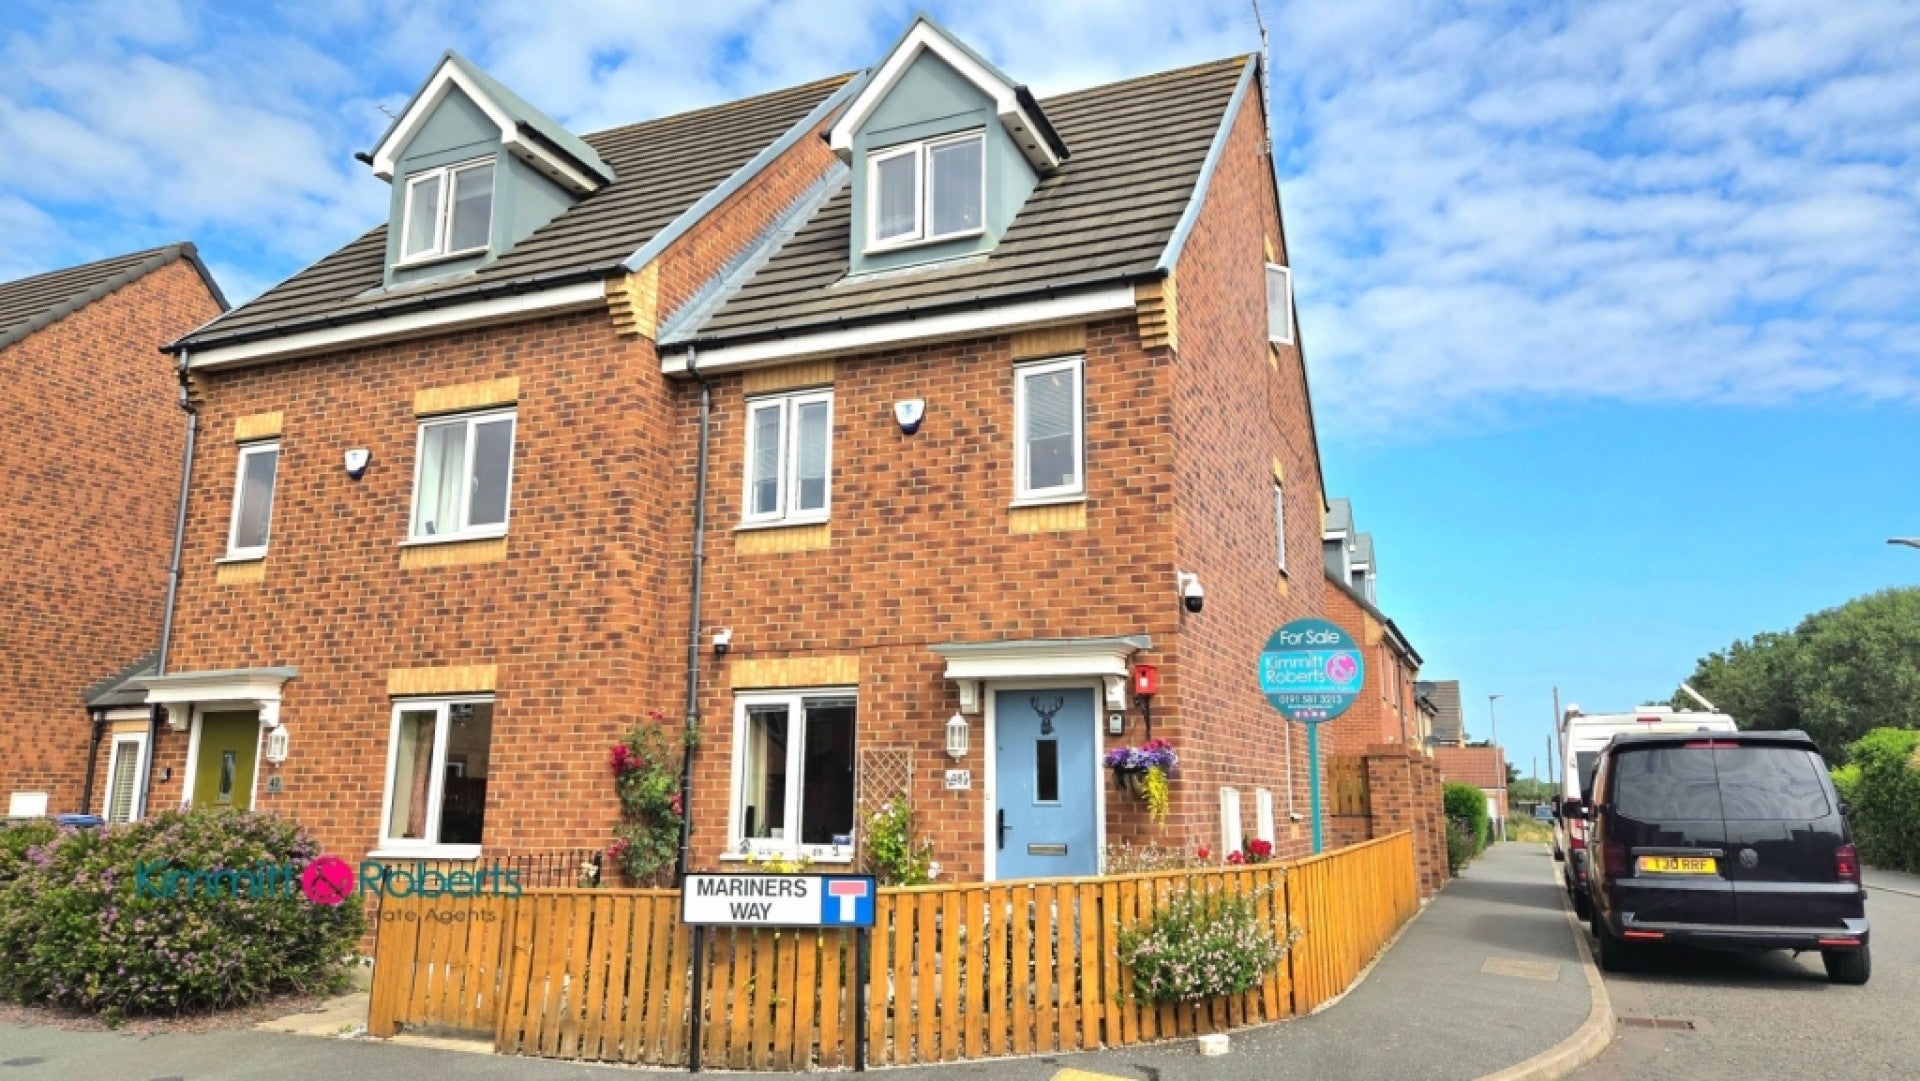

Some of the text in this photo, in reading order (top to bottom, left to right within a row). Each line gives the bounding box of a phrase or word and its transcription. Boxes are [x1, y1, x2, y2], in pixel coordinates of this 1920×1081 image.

[1280, 628, 1340, 645] For Sale
[1265, 655, 1324, 669] Kimmitt
[1265, 670, 1326, 684] Roberts
[697, 878, 807, 898] MARINERS
[729, 902, 773, 921] WAY
